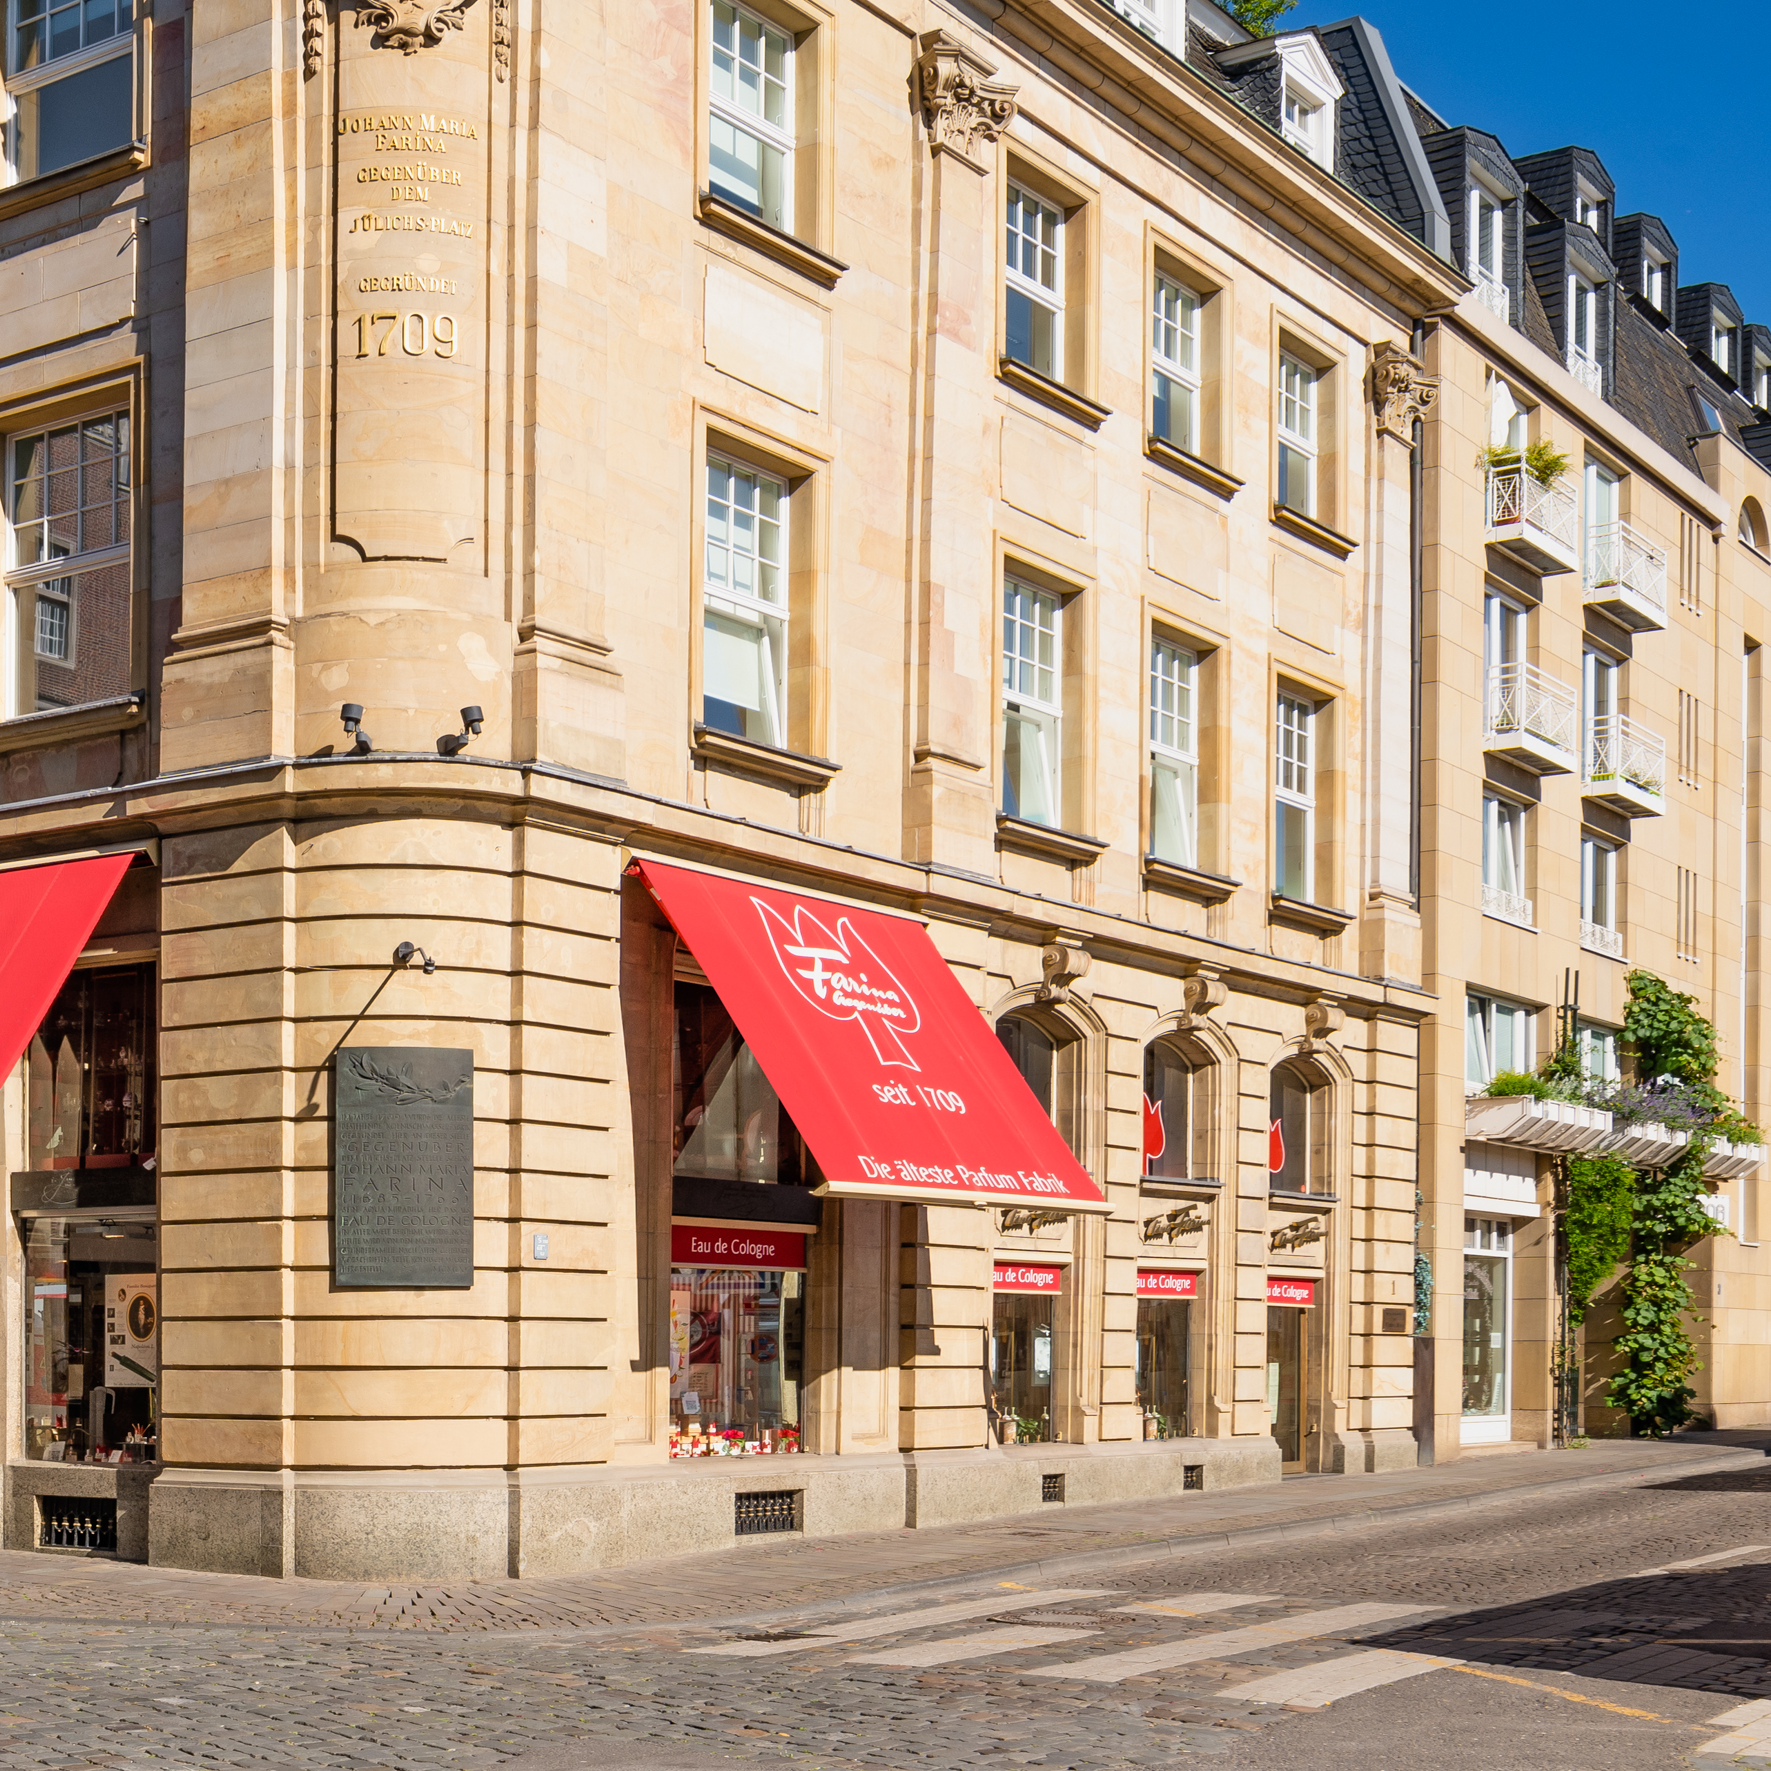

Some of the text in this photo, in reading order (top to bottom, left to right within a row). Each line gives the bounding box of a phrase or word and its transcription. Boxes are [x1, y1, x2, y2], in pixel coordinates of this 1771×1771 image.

[338, 113, 478, 140] JOHANN MARIA
[375, 132, 447, 153] FARINA
[357, 161, 462, 186] GEGENÜBER
[391, 185, 430, 202] DEM
[359, 272, 458, 295] GEGRÜNDET
[351, 312, 459, 360] 1709
[783, 944, 900, 1003] Farina
[872, 1080, 966, 1114] seit 1709
[341, 1164, 469, 1176] JOHANN MARIA
[858, 1155, 1070, 1194] Die älteste Parfum Fabrik
[342, 1176, 468, 1192] FARINA
[341, 1215, 470, 1227] EAU DE COLOGNE
[691, 1237, 775, 1259] Eau de Cologne
[1005, 1268, 1016, 1282] de
[1018, 1269, 1054, 1287] Cologne
[1147, 1275, 1157, 1288] de
[1159, 1275, 1191, 1292] Cologne
[1391, 1280, 1396, 1295] 1
[1272, 1284, 1281, 1296] de
[1282, 1285, 1309, 1301] Cologne
